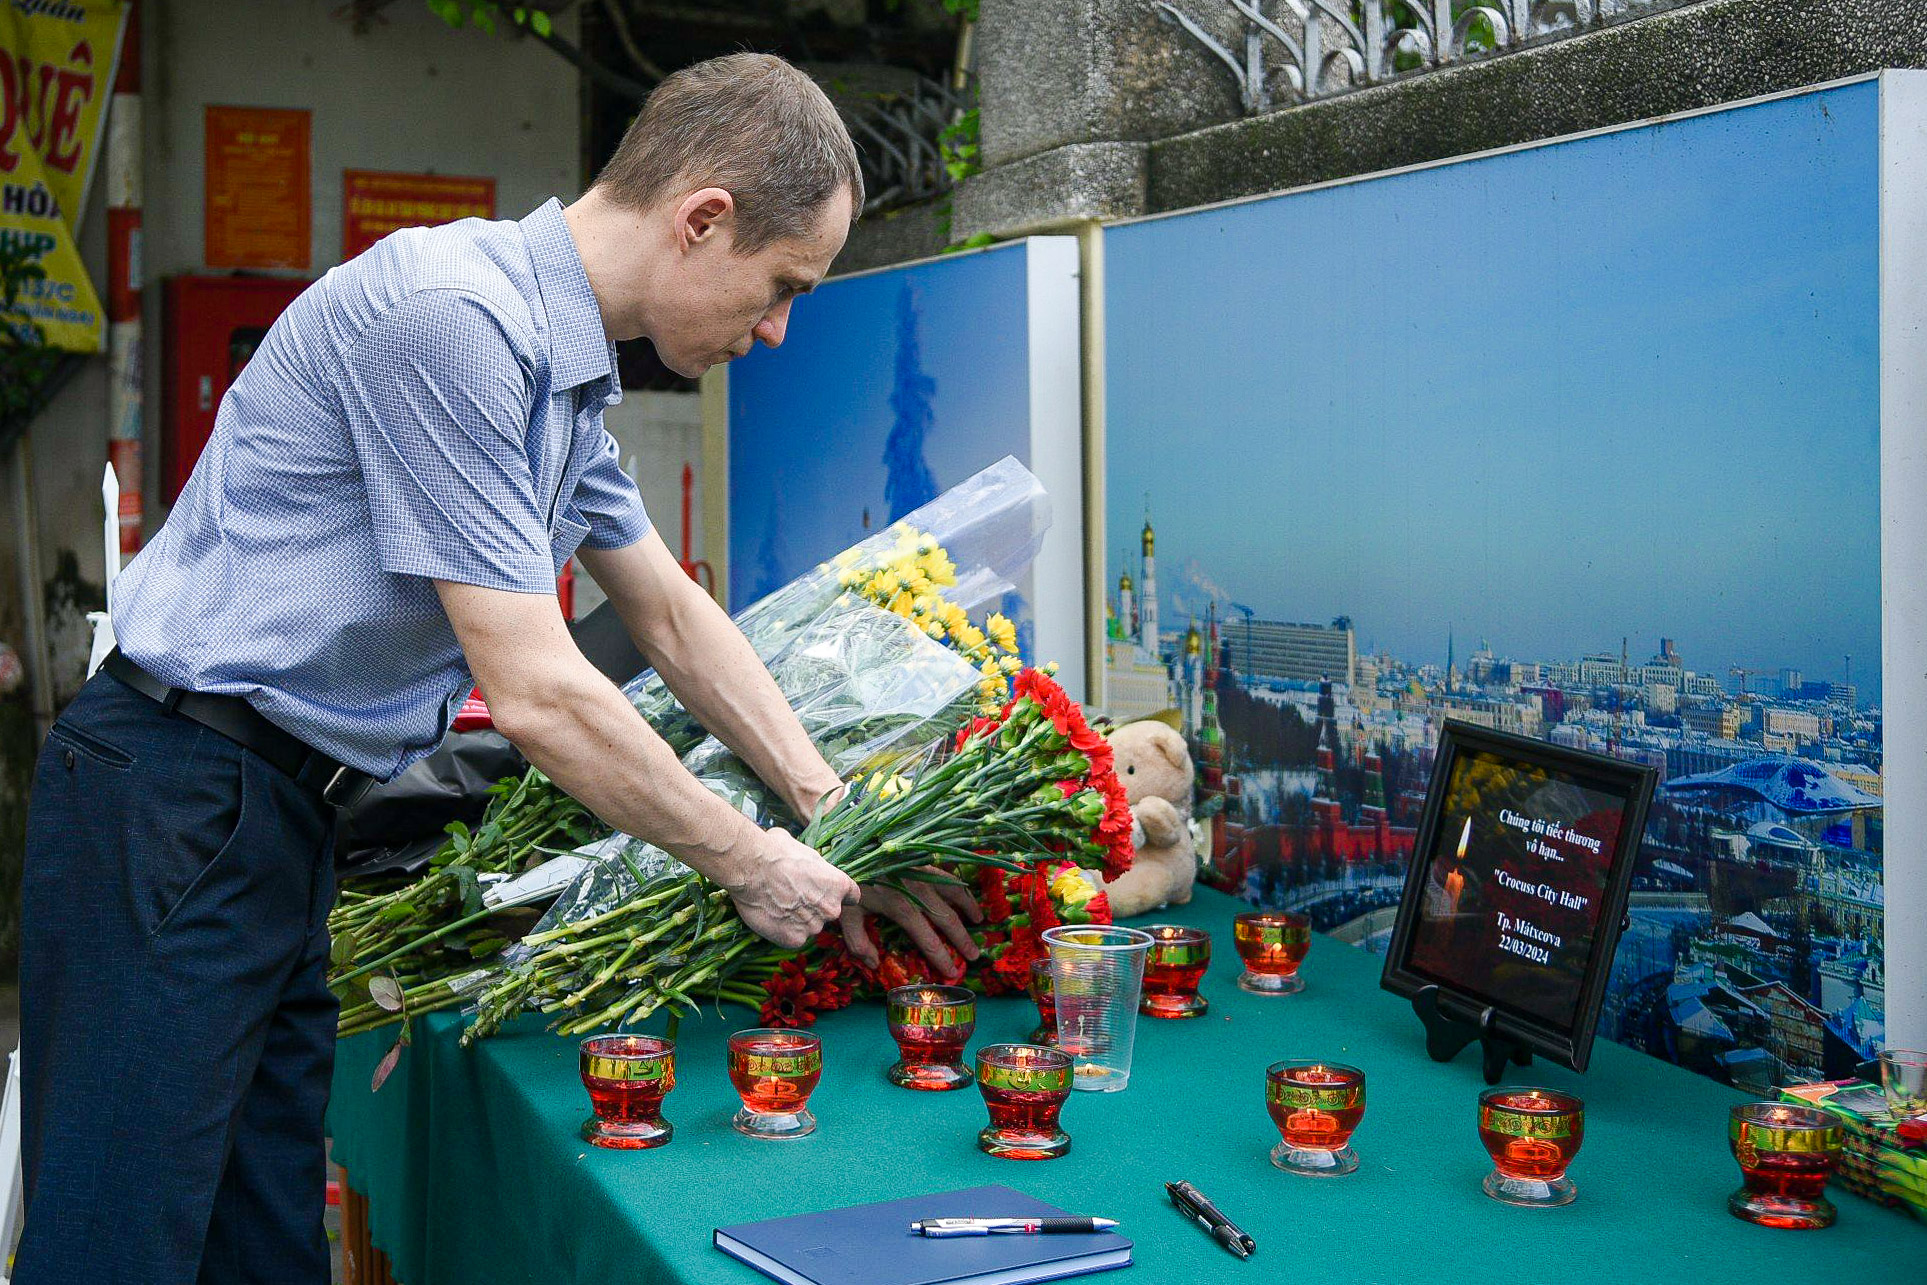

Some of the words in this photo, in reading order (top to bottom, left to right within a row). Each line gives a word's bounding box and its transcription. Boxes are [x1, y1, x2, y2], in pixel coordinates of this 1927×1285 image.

[1499, 809, 1530, 832] Chúng
[1531, 818, 1545, 834] tôi
[1546, 820, 1563, 839] tiếc
[1565, 828, 1600, 853] thương
[1525, 838, 1538, 853] vô
[1538, 842, 1564, 862] hạn...
[1494, 868, 1535, 894] "Crocuss
[1537, 883, 1558, 905] City
[1559, 890, 1587, 910] Hall"
[1497, 911, 1512, 932] Tp.
[1498, 934, 1549, 964] 22/03/2024
